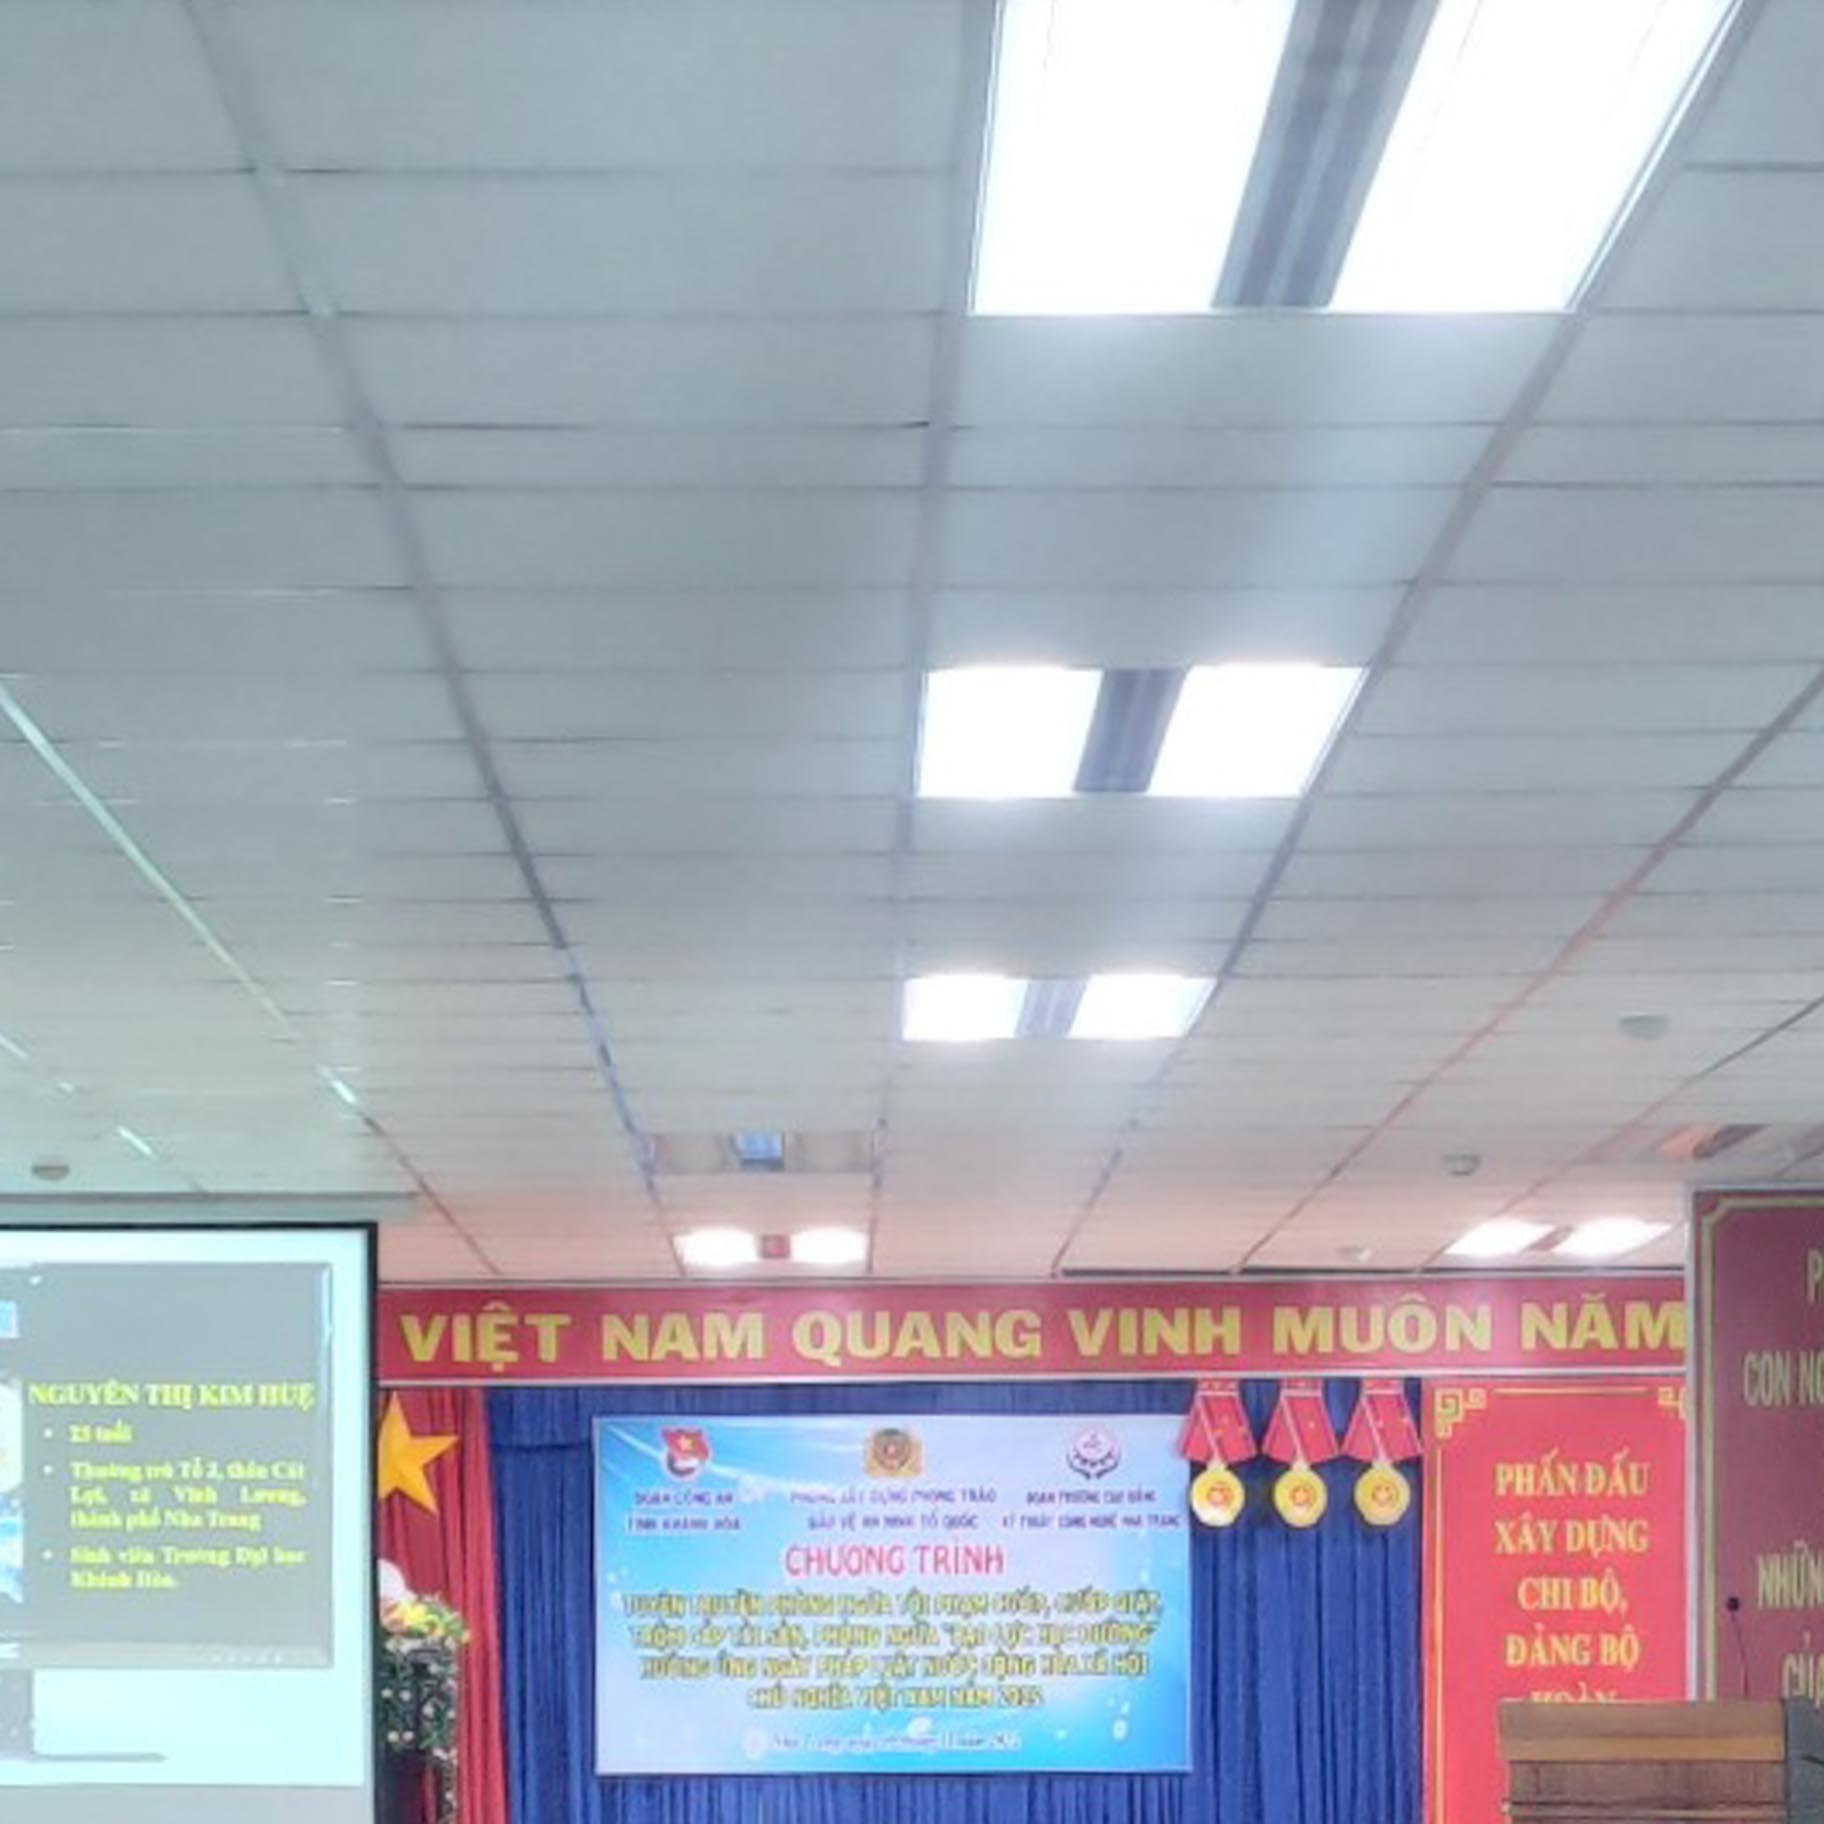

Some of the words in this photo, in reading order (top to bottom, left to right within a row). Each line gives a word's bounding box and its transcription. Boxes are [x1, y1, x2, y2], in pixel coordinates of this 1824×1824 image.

[400, 1302, 571, 1371] VIỆT
[603, 1312, 766, 1361] NAM
[793, 1310, 1042, 1366] QUANG
[1069, 1307, 1242, 1356] VINH
[1274, 1294, 1492, 1354] MUÔN
[1521, 1293, 1687, 1350] NĂM
[200, 1384, 252, 1406] KIM
[1743, 1350, 1791, 1406] CON
[1494, 1447, 1576, 1497] PHẤN
[1584, 1447, 1650, 1496] ĐẤU
[785, 1544, 906, 1576] CHƯƠNG
[914, 1537, 1004, 1576] TRÌNH
[1495, 1512, 1558, 1555] XÂY
[1565, 1514, 1649, 1560] DỰNG
[1517, 1576, 1572, 1610] CHI
[1580, 1567, 1629, 1617] BỘ,
[1505, 1622, 1591, 1668] ĐẢNG
[1600, 1624, 1642, 1672] BỘ
